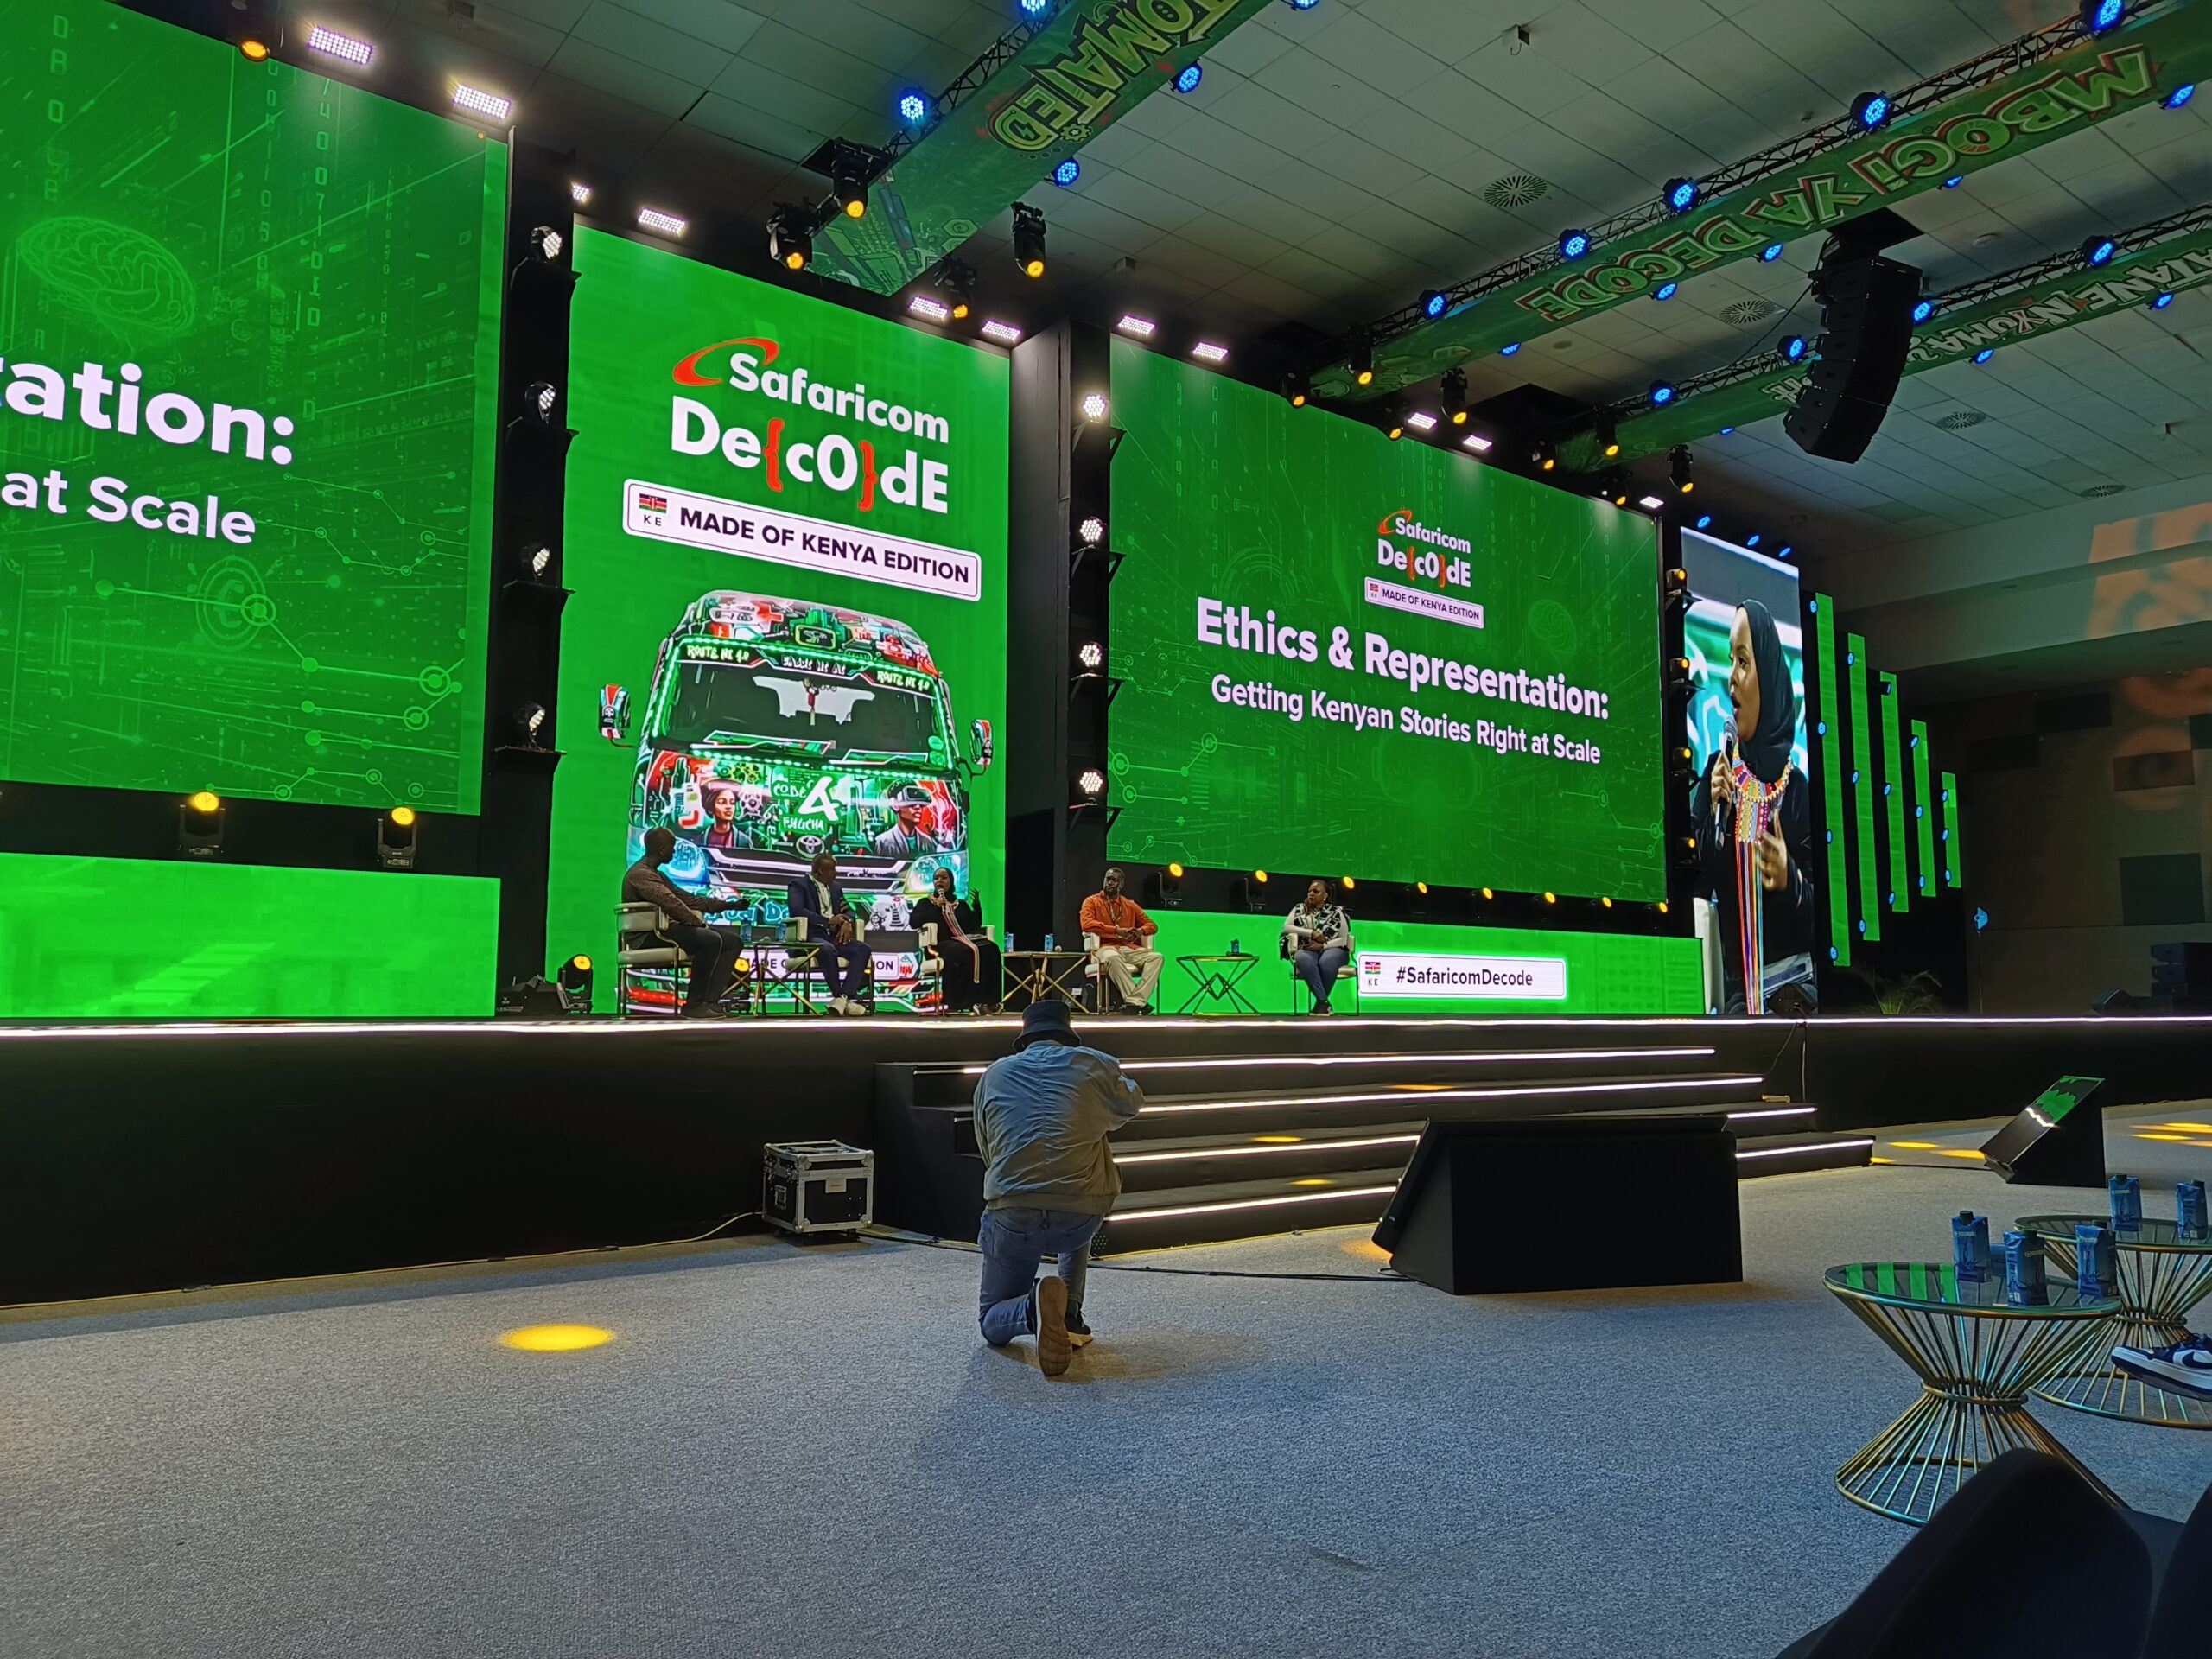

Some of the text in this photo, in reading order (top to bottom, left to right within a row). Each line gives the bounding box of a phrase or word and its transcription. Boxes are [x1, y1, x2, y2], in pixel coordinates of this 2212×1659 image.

[1515, 44, 2154, 322] MBOGI YA DECODE
[0, 357, 294, 465] ation:
[729, 352, 949, 444] Safaricom
[1, 469, 256, 543] at Scale
[1395, 517, 1471, 554] Safaricom
[680, 507, 969, 583] MADE OF KENYA EDITION
[1382, 588, 1406, 602] MADE
[1408, 594, 1419, 606] OF
[1421, 598, 1446, 612] KENYA
[1449, 606, 1479, 620] EDITION
[1198, 597, 1609, 720] Ethics & Representation:
[1211, 674, 1601, 765] Getting Kenyan Stories Right at Scale
[798, 776, 840, 821] 4
[1396, 966, 1533, 986] #SafaricomDecode
